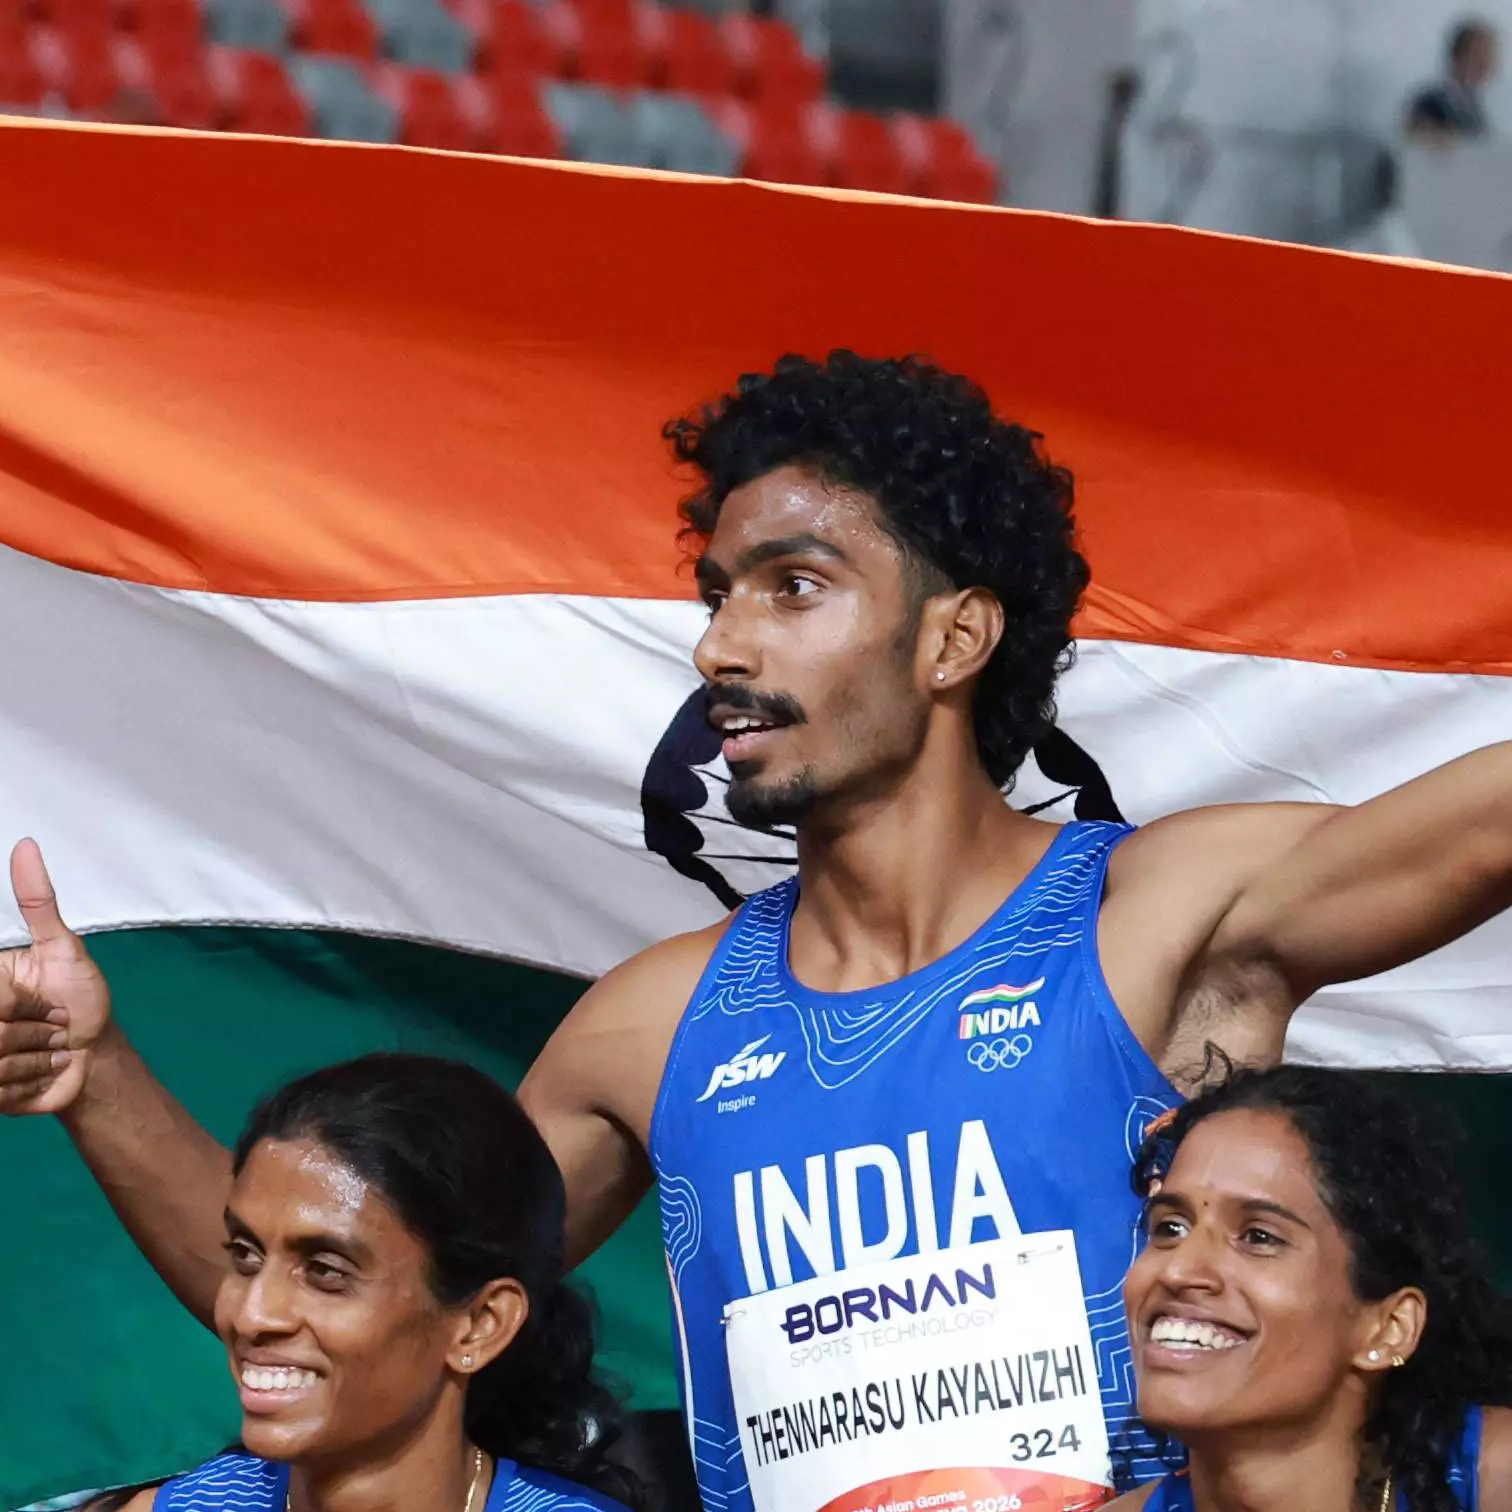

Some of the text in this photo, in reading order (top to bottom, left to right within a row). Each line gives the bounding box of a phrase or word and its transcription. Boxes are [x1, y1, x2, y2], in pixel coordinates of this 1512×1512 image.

[959, 1001, 1042, 1041] INDIA
[696, 1049, 786, 1103] JSW
[717, 1093, 756, 1114] Inspire
[733, 1119, 1023, 1295] INDIA
[780, 1263, 996, 1344] BORNAN
[789, 1307, 999, 1369] SPORTS TECHNOLOGY
[746, 1344, 1087, 1467] THENNARASU KAYALVIZHI
[1009, 1423, 1082, 1462] 324
[916, 1490, 966, 1507] Games
